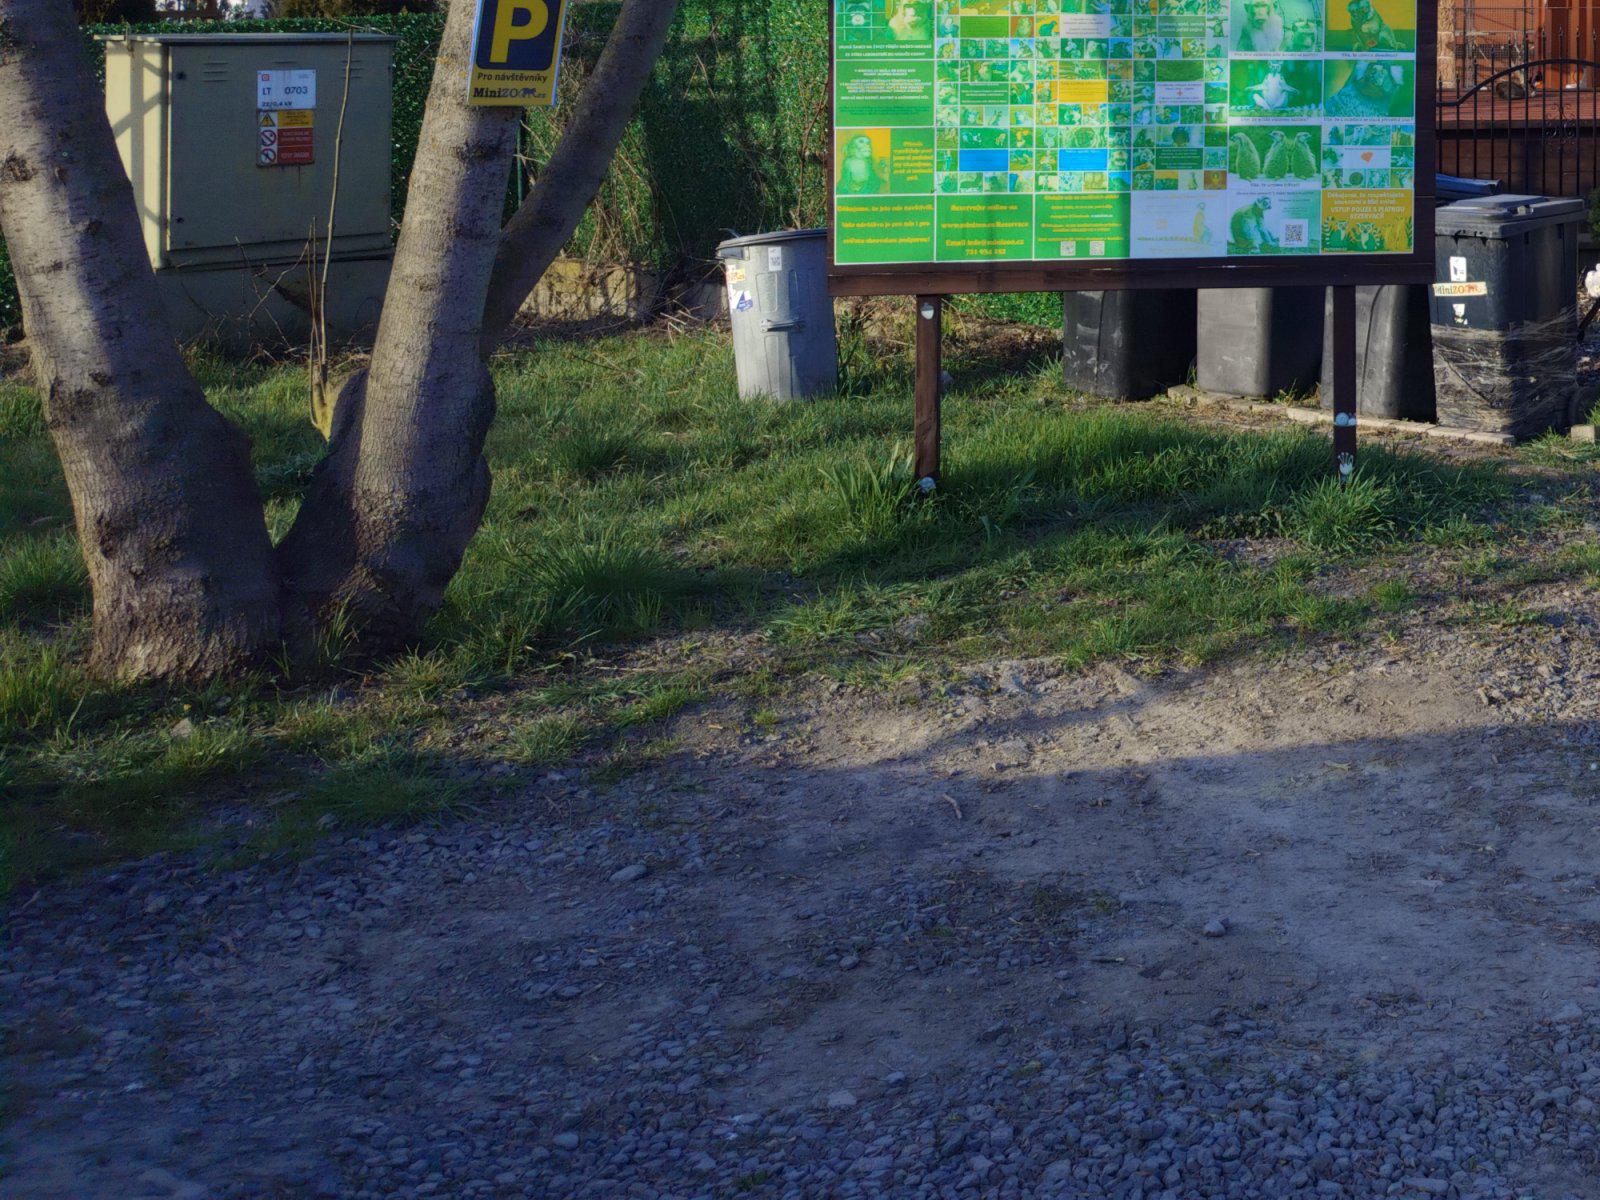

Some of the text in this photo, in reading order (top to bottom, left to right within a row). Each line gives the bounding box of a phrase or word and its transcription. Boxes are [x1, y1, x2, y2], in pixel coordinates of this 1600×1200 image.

[477, 73, 547, 84] Pro návštěvníky
[262, 86, 308, 95] LT 0703
